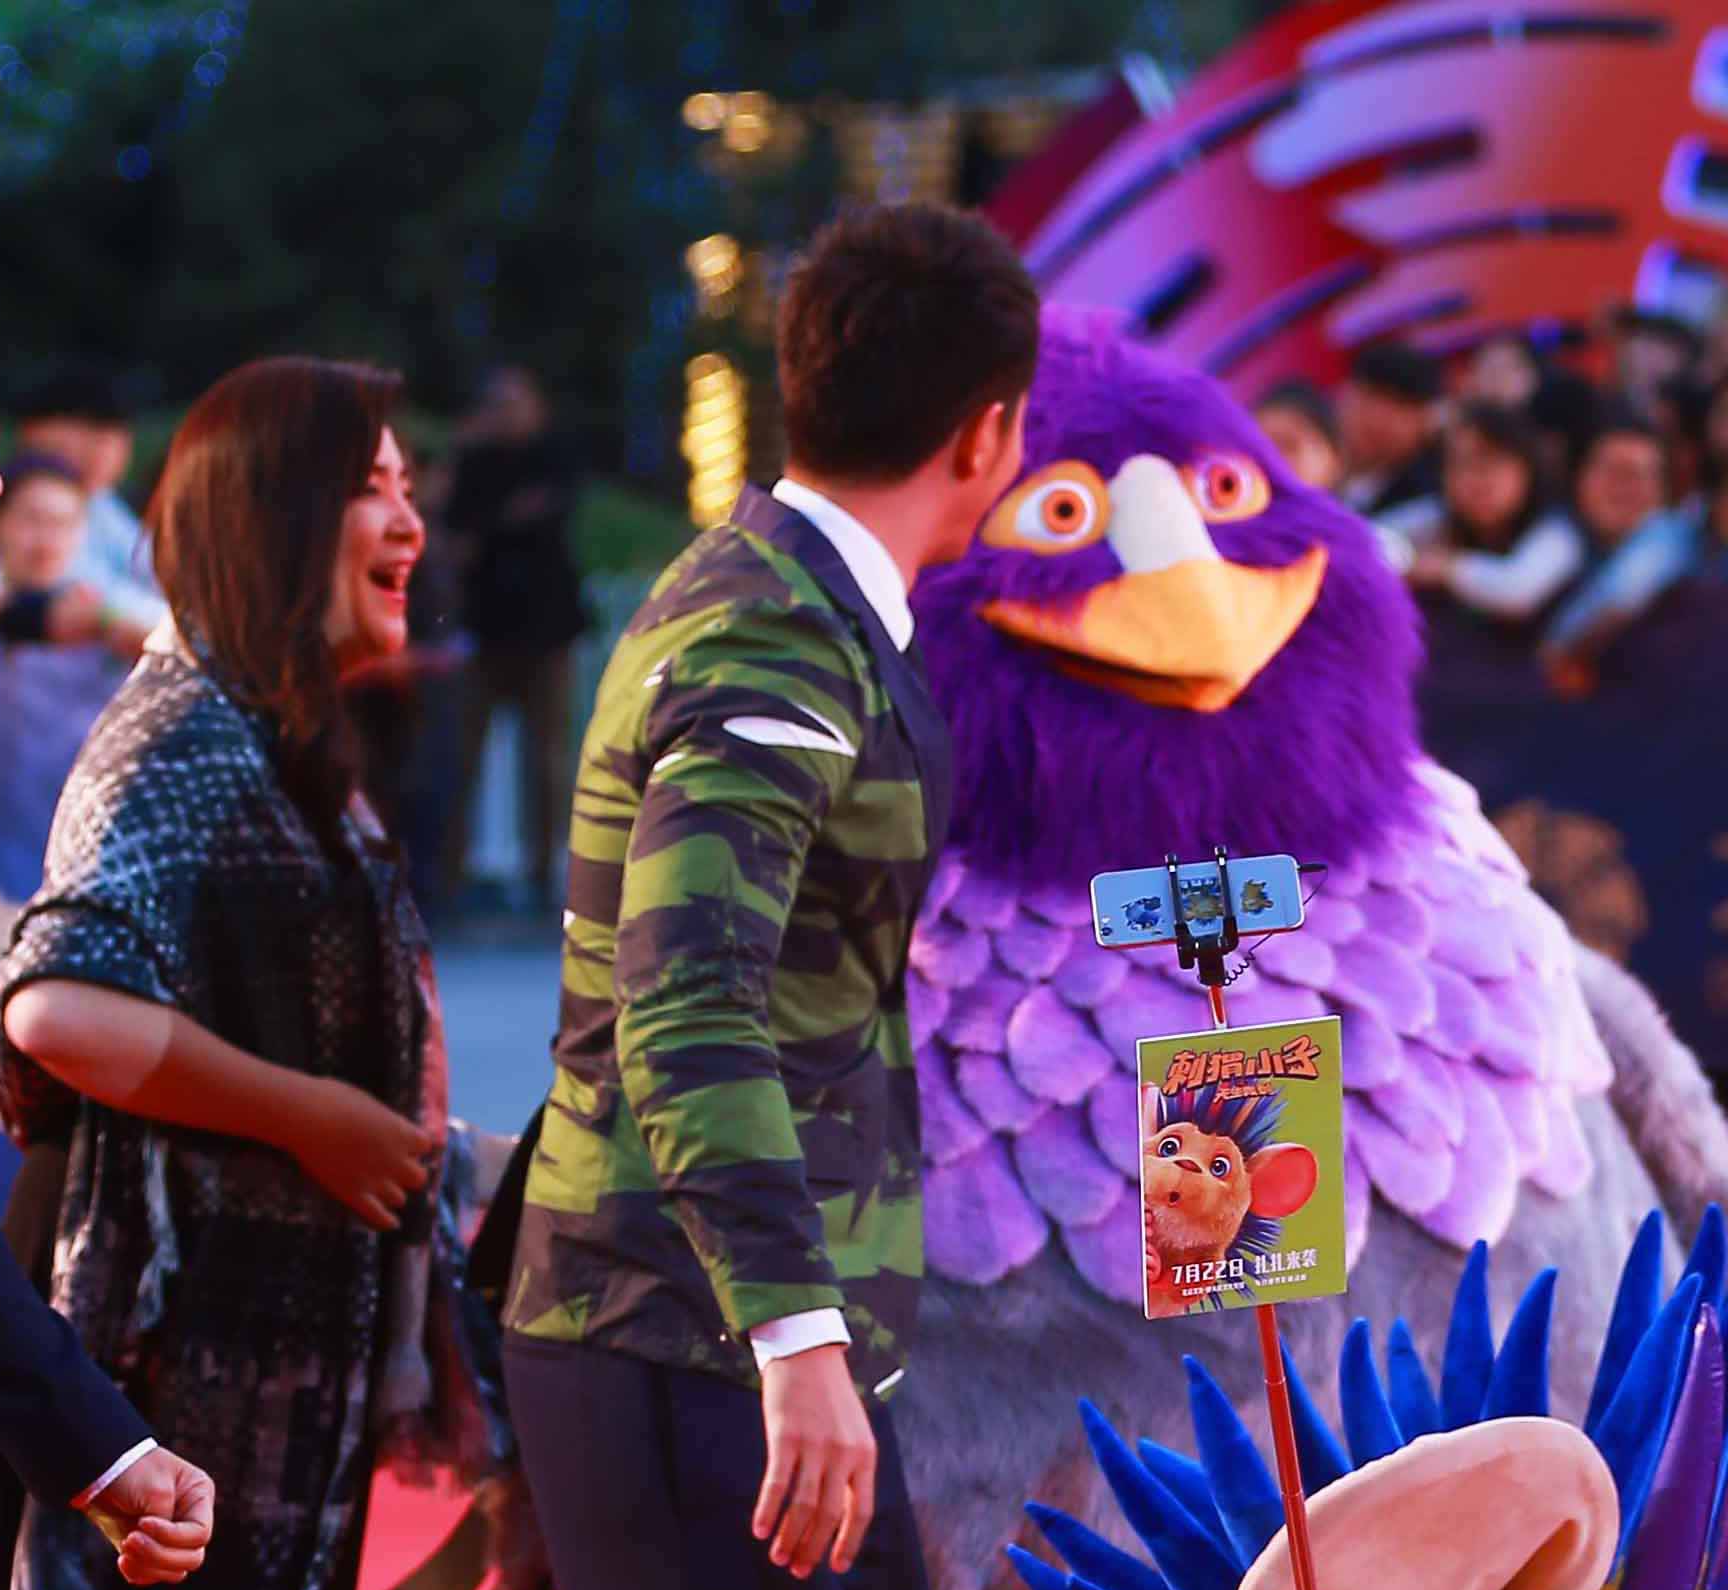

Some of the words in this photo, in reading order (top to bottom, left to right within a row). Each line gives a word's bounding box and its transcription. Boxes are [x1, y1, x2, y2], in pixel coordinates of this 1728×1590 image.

[1162, 1035, 1321, 1095] 刺猬小子
[1172, 1259, 1244, 1284] 7月22日
